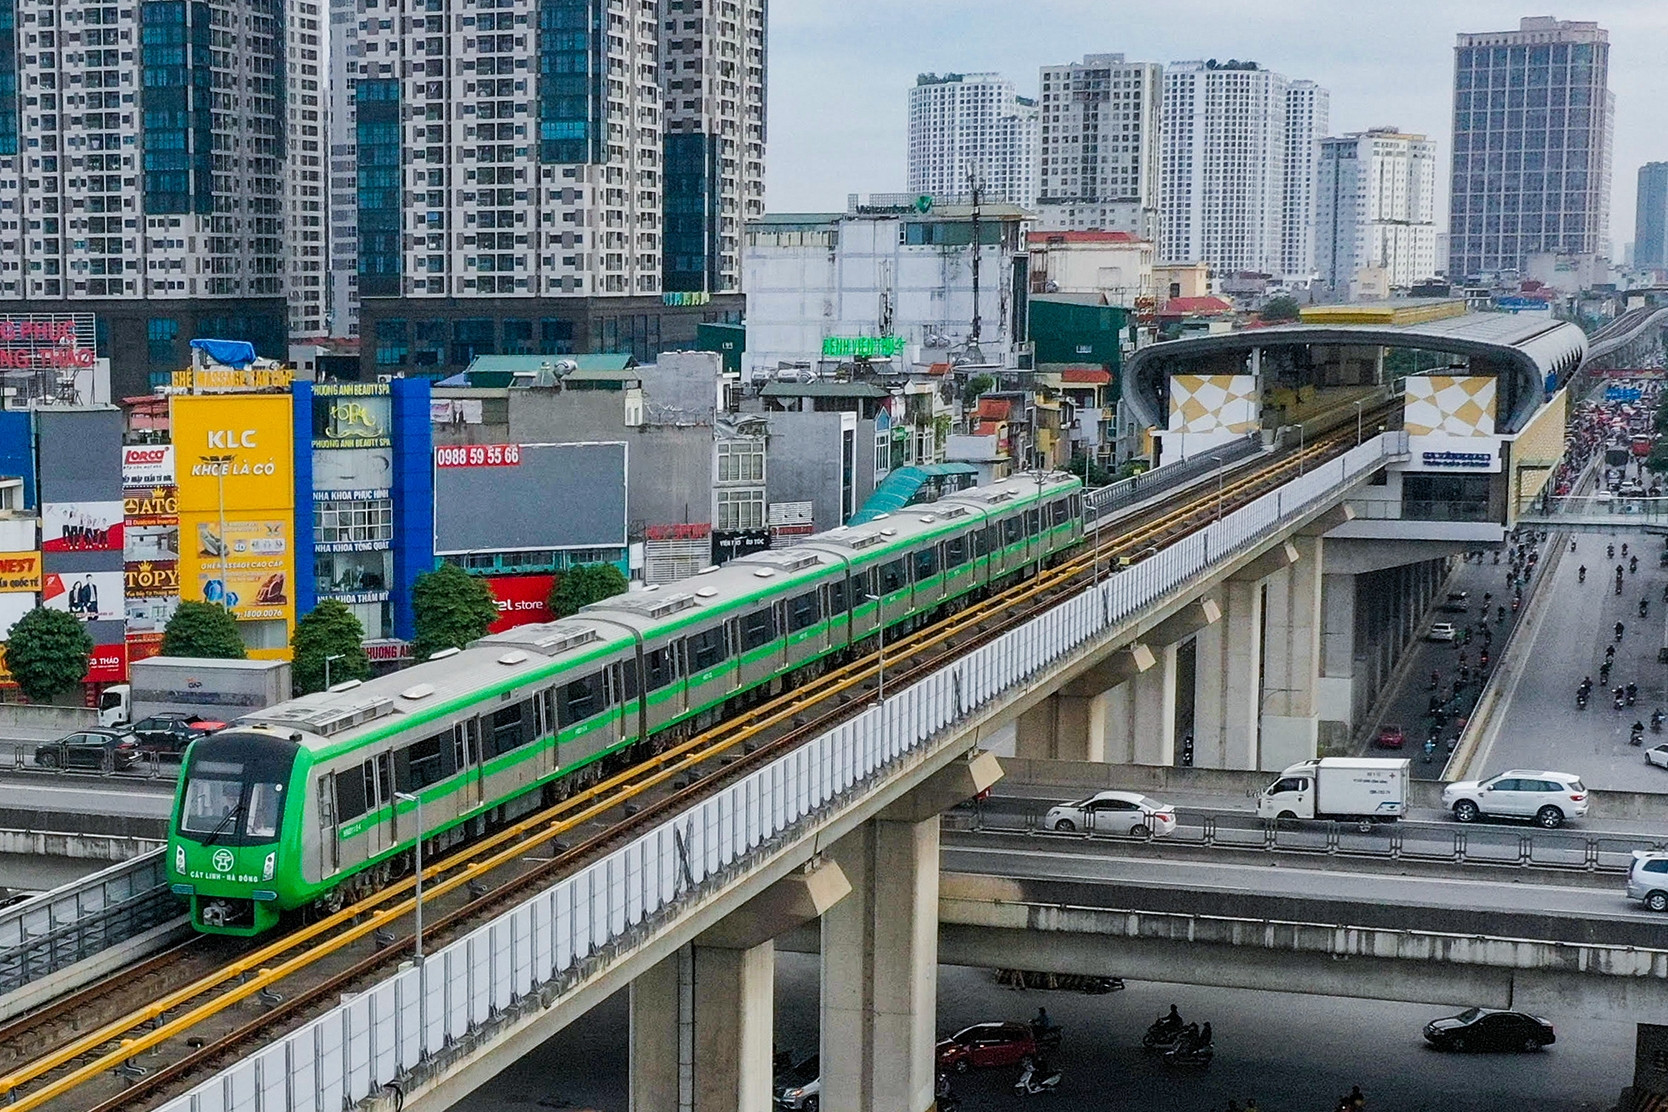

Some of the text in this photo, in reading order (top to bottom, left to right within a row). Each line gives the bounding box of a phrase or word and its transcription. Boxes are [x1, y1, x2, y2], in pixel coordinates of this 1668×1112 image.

[378, 383, 391, 395] SPA
[208, 430, 257, 449] KLC
[380, 438, 391, 447] SPA
[437, 446, 519, 466] 0988 59 55 66
[253, 456, 275, 475] CÓ
[331, 491, 352, 501] KHOA
[140, 497, 178, 514] ATG
[333, 543, 353, 552] KHOA
[124, 570, 178, 588] TOPY
[336, 594, 356, 604] KHOA
[515, 600, 543, 610] store
[205, 872, 220, 880] LINH
